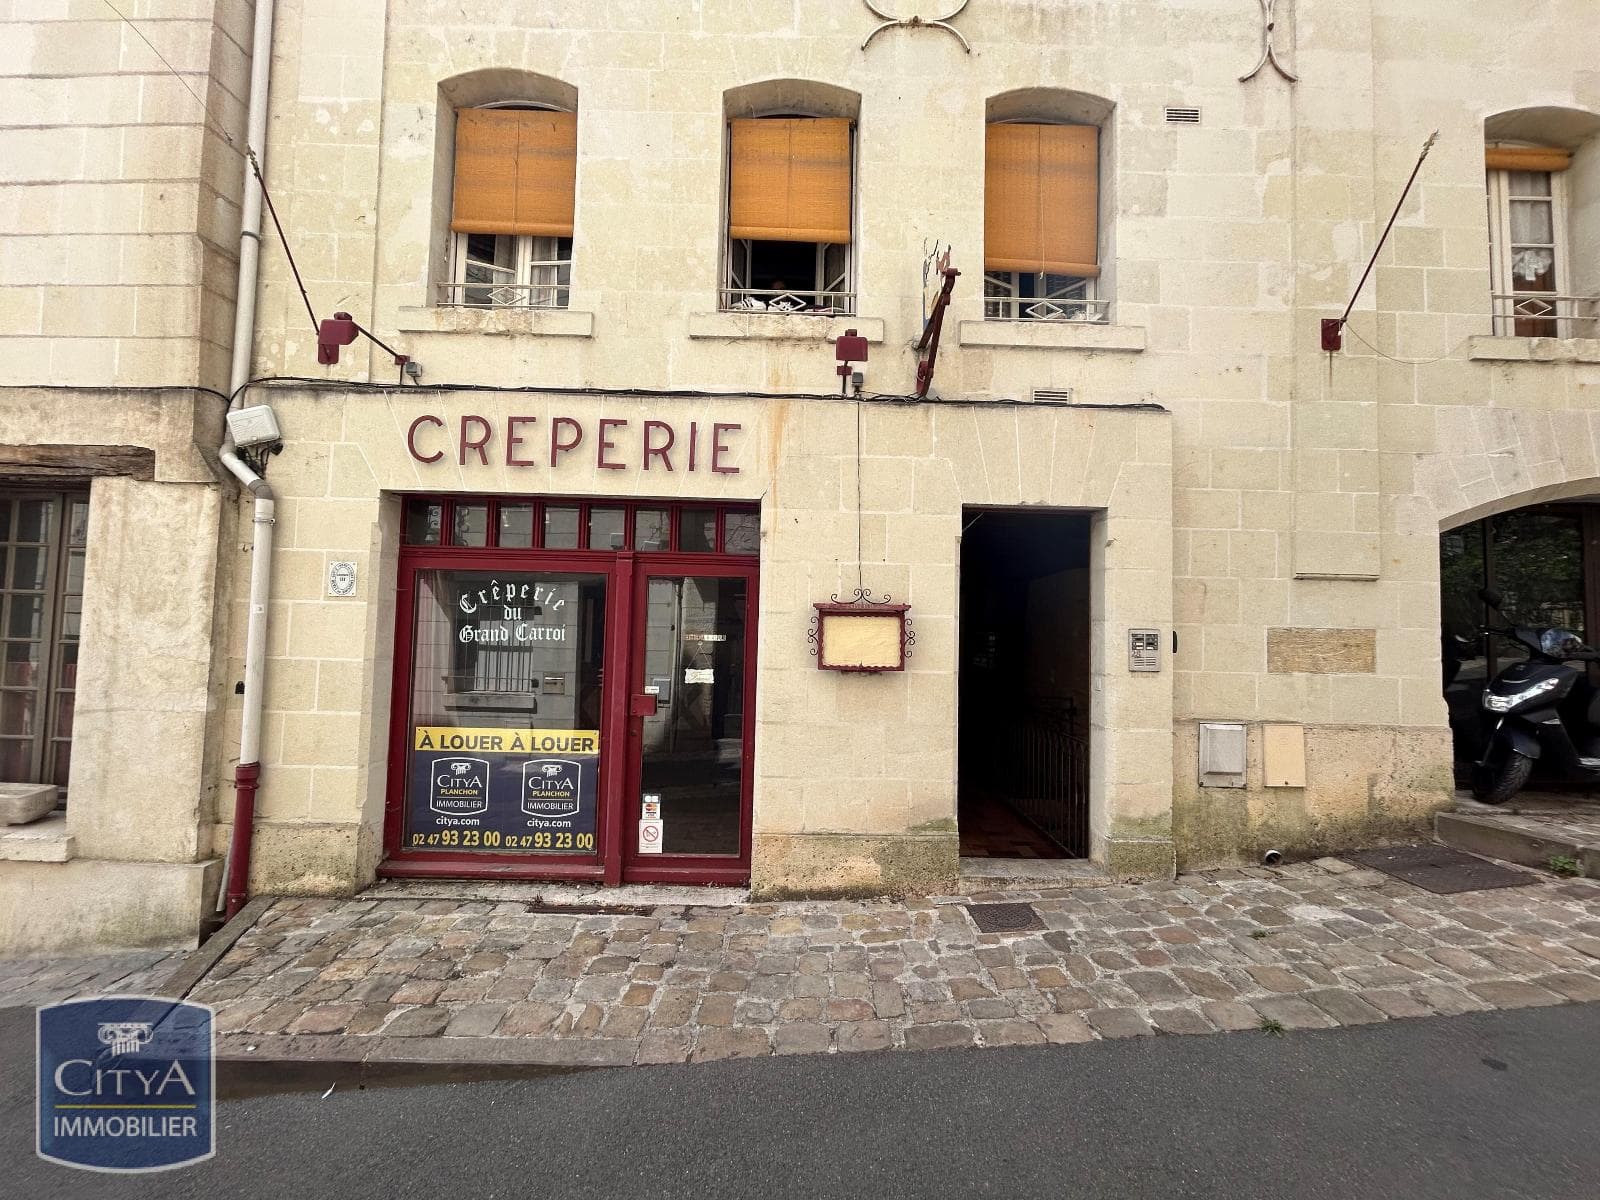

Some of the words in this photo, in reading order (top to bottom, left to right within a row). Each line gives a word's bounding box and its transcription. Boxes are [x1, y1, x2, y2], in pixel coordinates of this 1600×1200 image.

[407, 414, 742, 474] CREPERIE
[459, 579, 565, 614] Crêperie
[503, 604, 522, 620] du
[459, 624, 509, 643] Grand
[515, 622, 566, 641] Carroi
[419, 730, 434, 749] À
[440, 734, 503, 750] LOUER
[510, 732, 525, 751] À
[531, 736, 594, 752] LOUER
[440, 788, 478, 796] PLANCHON
[436, 800, 482, 809] IMMOBILIER
[527, 802, 574, 811] IMMOBILIER
[436, 815, 480, 826] citya.com
[527, 817, 571, 828] citya.com
[412, 834, 425, 845] 02
[427, 834, 440, 845] 47
[441, 830, 459, 846] 93
[463, 830, 480, 846] 23
[483, 831, 501, 846] 00
[505, 836, 517, 847] 02
[519, 835, 532, 847] 47
[534, 832, 551, 848] 93
[555, 832, 572, 848] 23
[576, 833, 594, 849] 00
